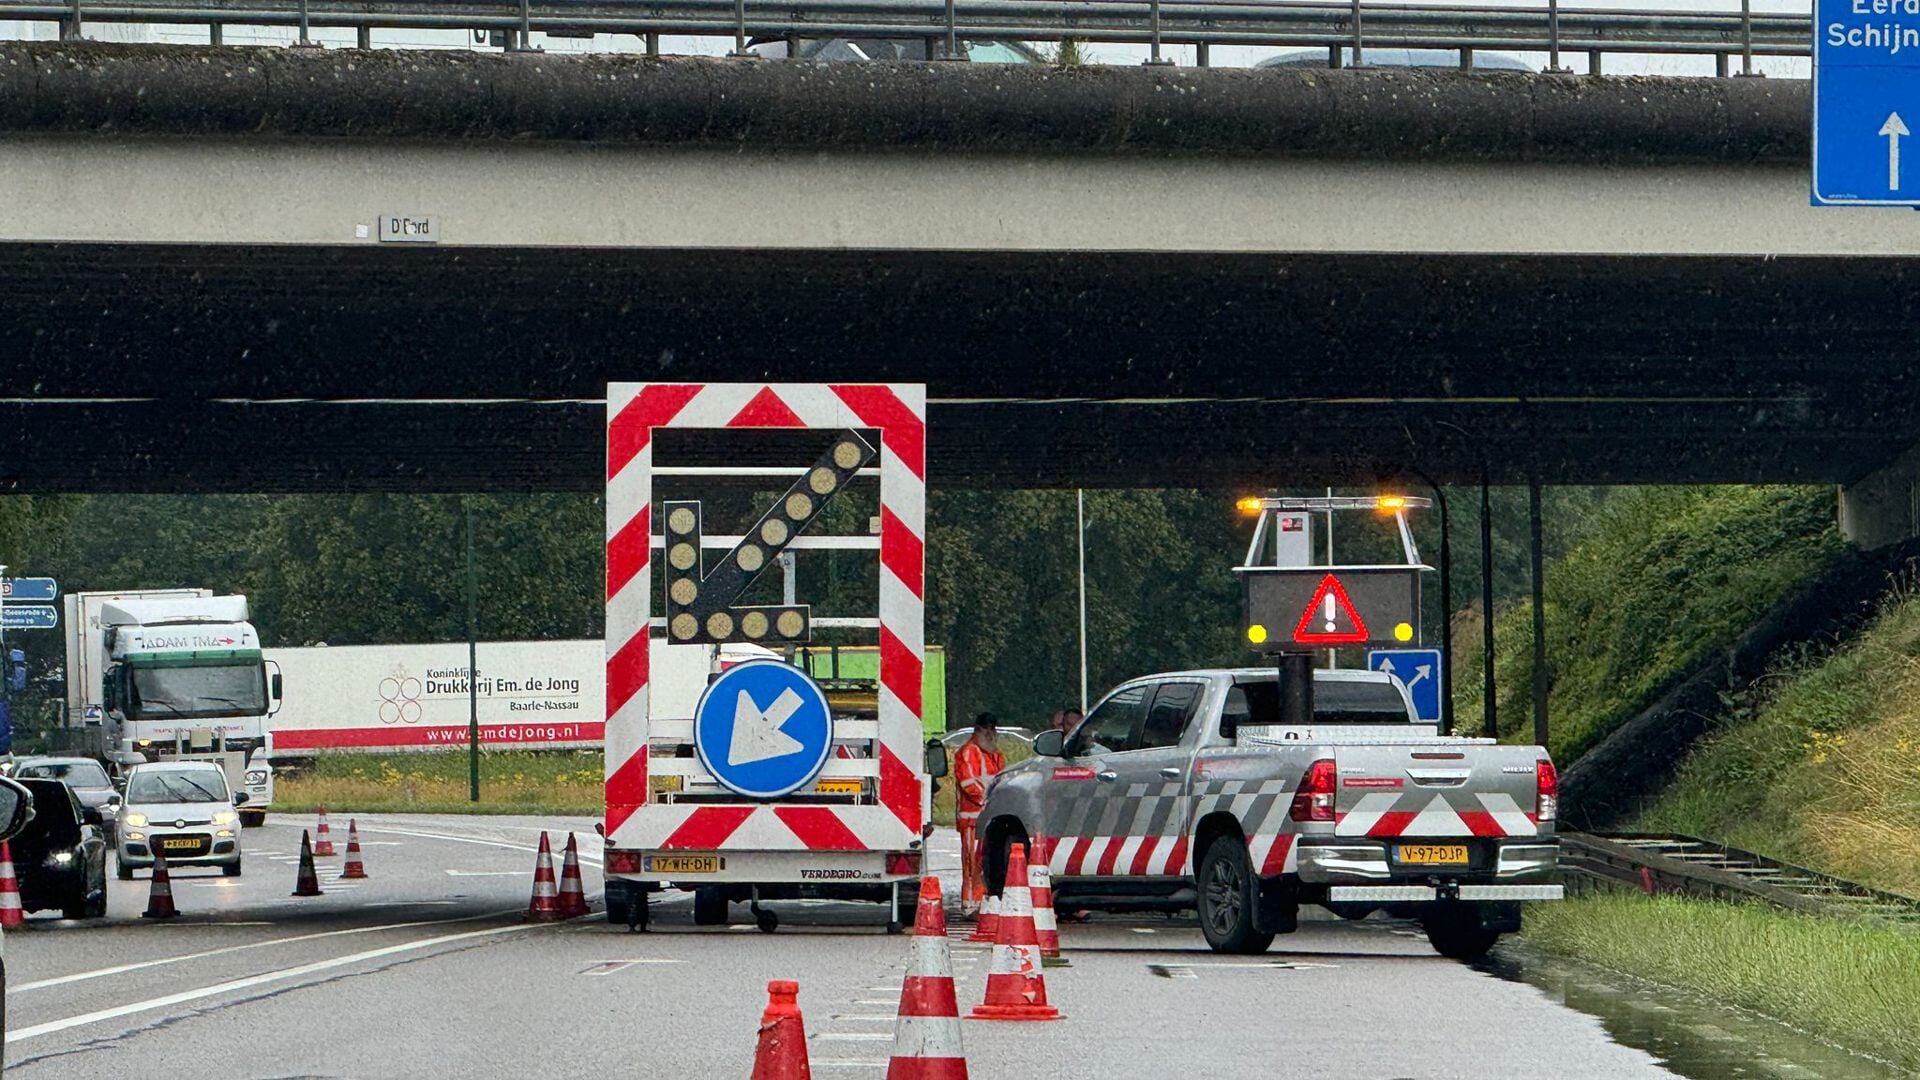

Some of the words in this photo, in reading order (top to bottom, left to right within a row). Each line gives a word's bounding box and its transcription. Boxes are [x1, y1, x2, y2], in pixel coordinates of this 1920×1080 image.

[1827, 22, 1919, 55] Schijn
[146, 637, 188, 649] ADAM
[426, 667, 481, 680] Koninklije
[426, 677, 492, 696] Drukkrij
[496, 678, 522, 692] Em.
[525, 677, 543, 691] de
[546, 677, 580, 693] Jong
[510, 701, 579, 711] Baarle-Nassau
[1404, 847, 1463, 862] V-97-DJP
